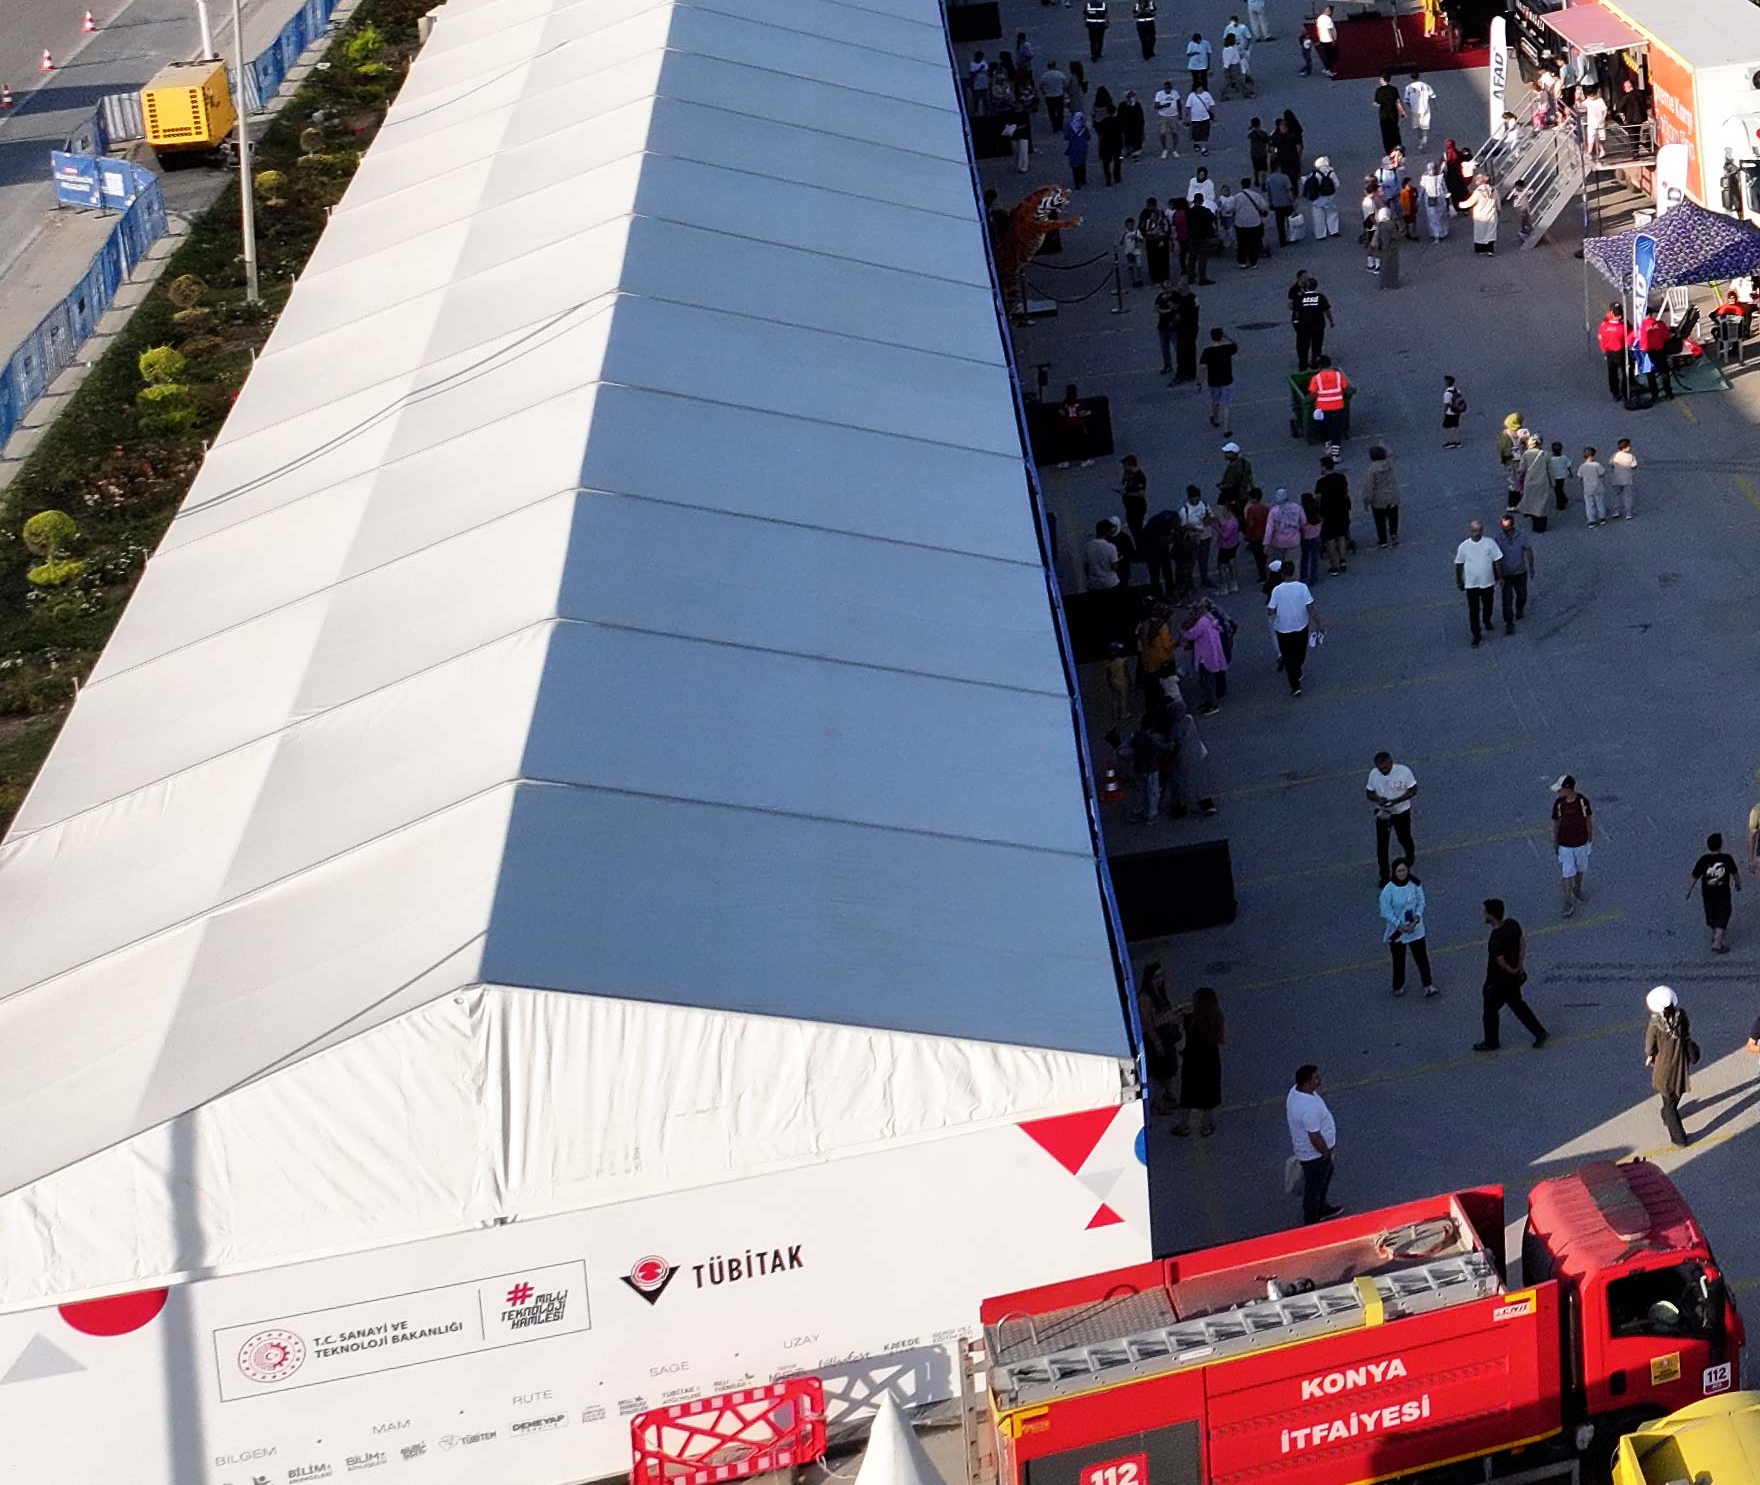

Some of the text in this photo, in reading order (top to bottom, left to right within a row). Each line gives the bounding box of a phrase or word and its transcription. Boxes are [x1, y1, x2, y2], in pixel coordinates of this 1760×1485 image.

[1492, 52, 1504, 100] AFAD
[692, 1245, 804, 1288] TÜBİTAK
[339, 1322, 388, 1343] SANAYİ
[783, 1333, 821, 1349] UZAY
[315, 1336, 390, 1359] TEKNOLOJİ
[650, 1361, 689, 1378] SAGE
[1301, 1358, 1407, 1401] KONYA
[1708, 1367, 1727, 1383] 112
[513, 1390, 553, 1406] RUTE
[372, 1419, 411, 1435] MAM
[1280, 1395, 1430, 1454] İTFAİYESİ
[1091, 1462, 1139, 1485] 112
